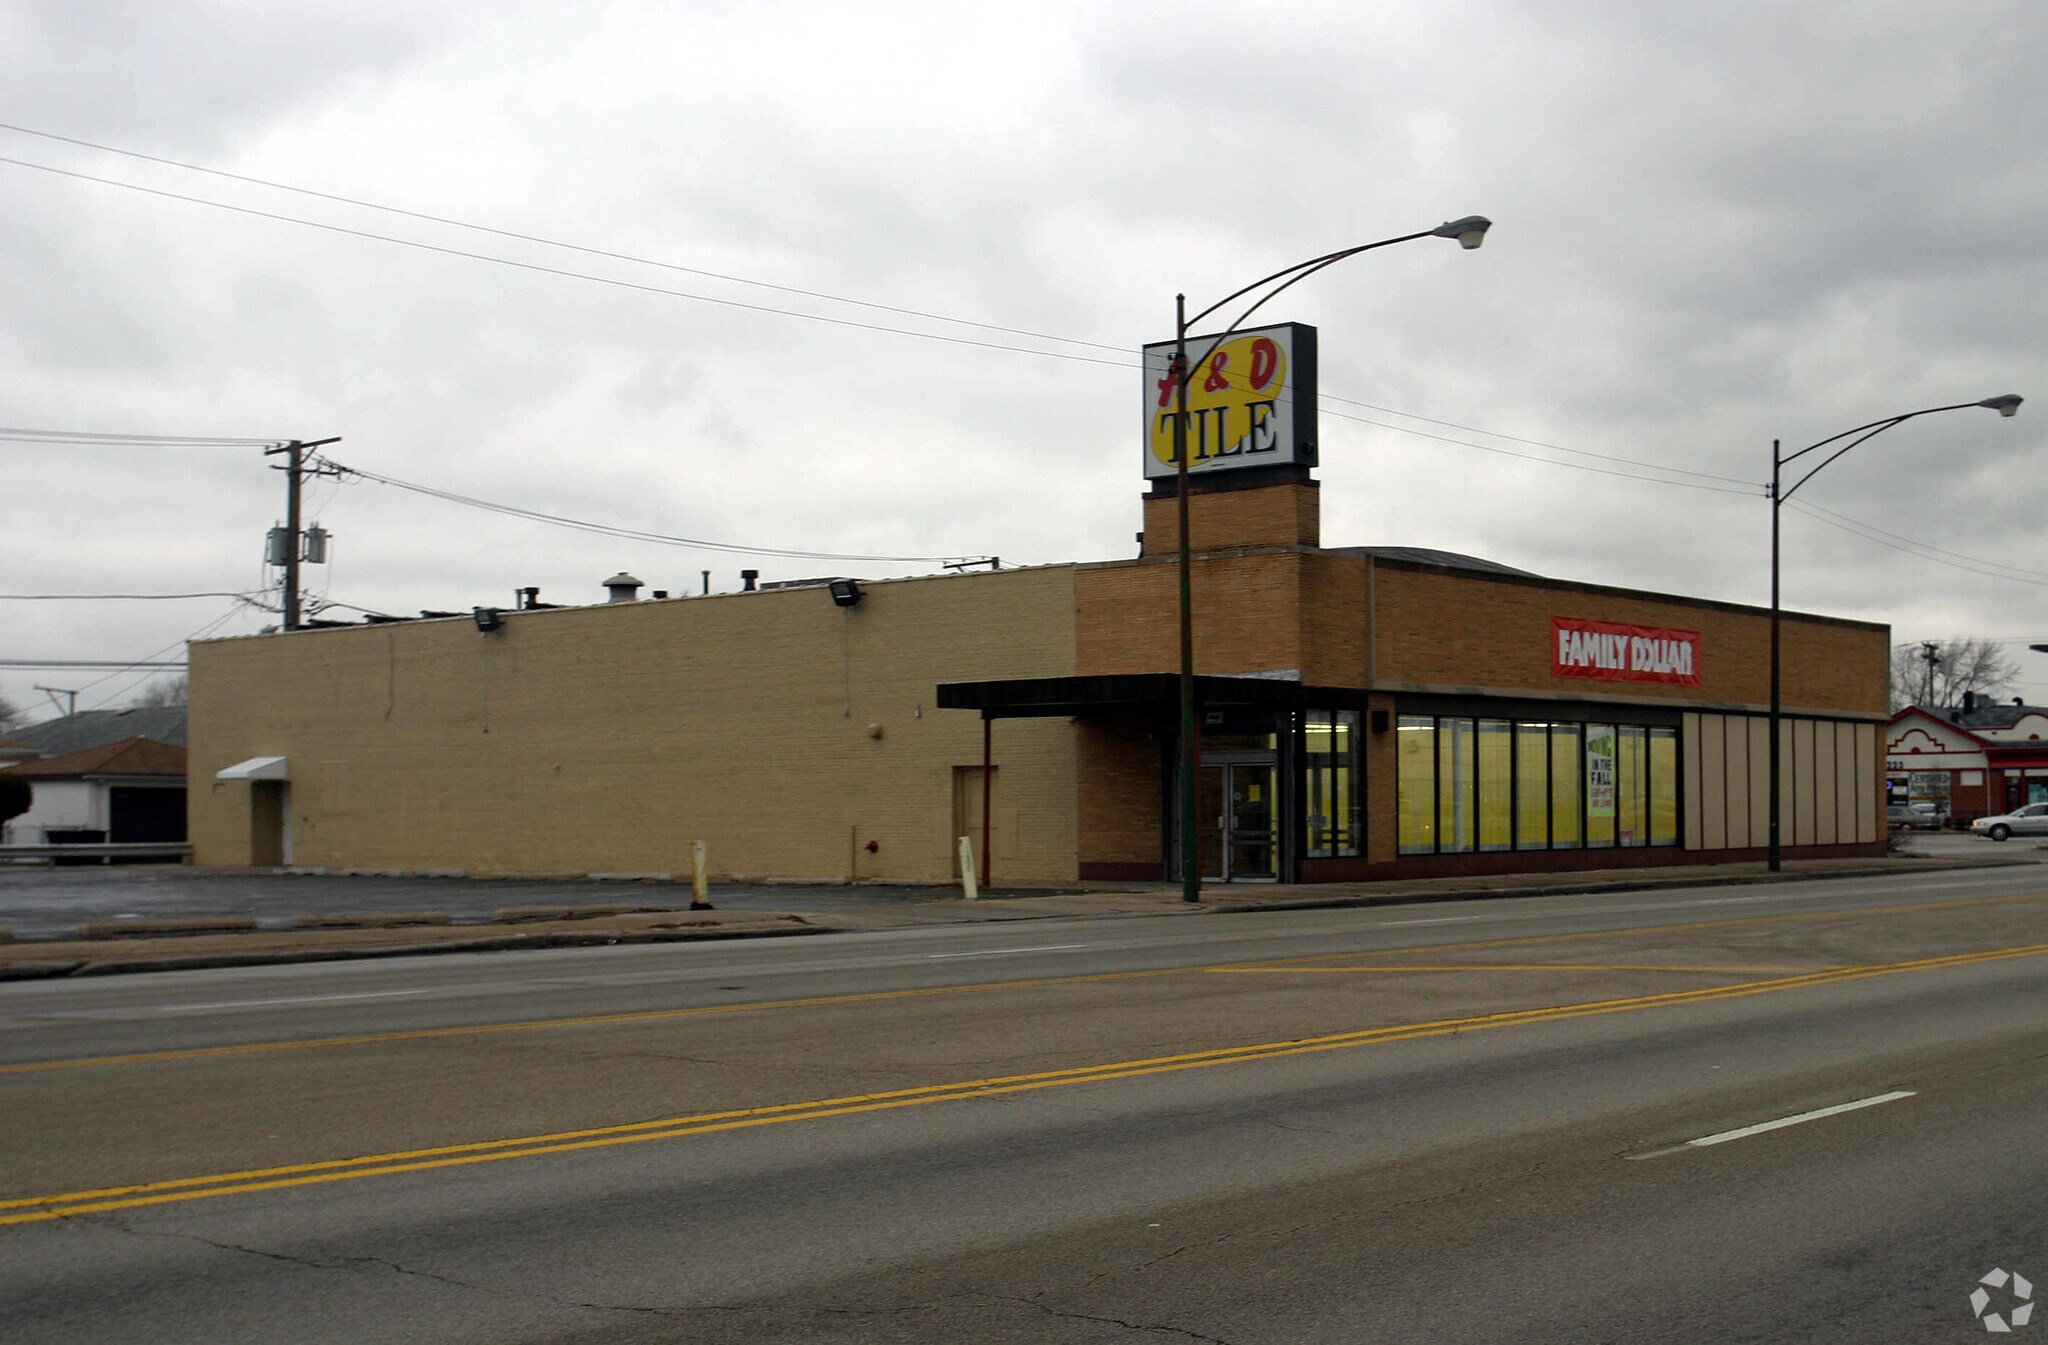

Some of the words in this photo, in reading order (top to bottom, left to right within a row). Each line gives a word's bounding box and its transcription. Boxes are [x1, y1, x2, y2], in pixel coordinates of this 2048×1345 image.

[1204, 351, 1230, 393] &
[1250, 338, 1277, 390] D
[1160, 400, 1277, 463] TILE
[1558, 629, 1629, 670] FAMILY
[1631, 635, 1693, 676] DOLLAR
[1591, 772, 1611, 786] FALL
[1601, 759, 1612, 771] THE
